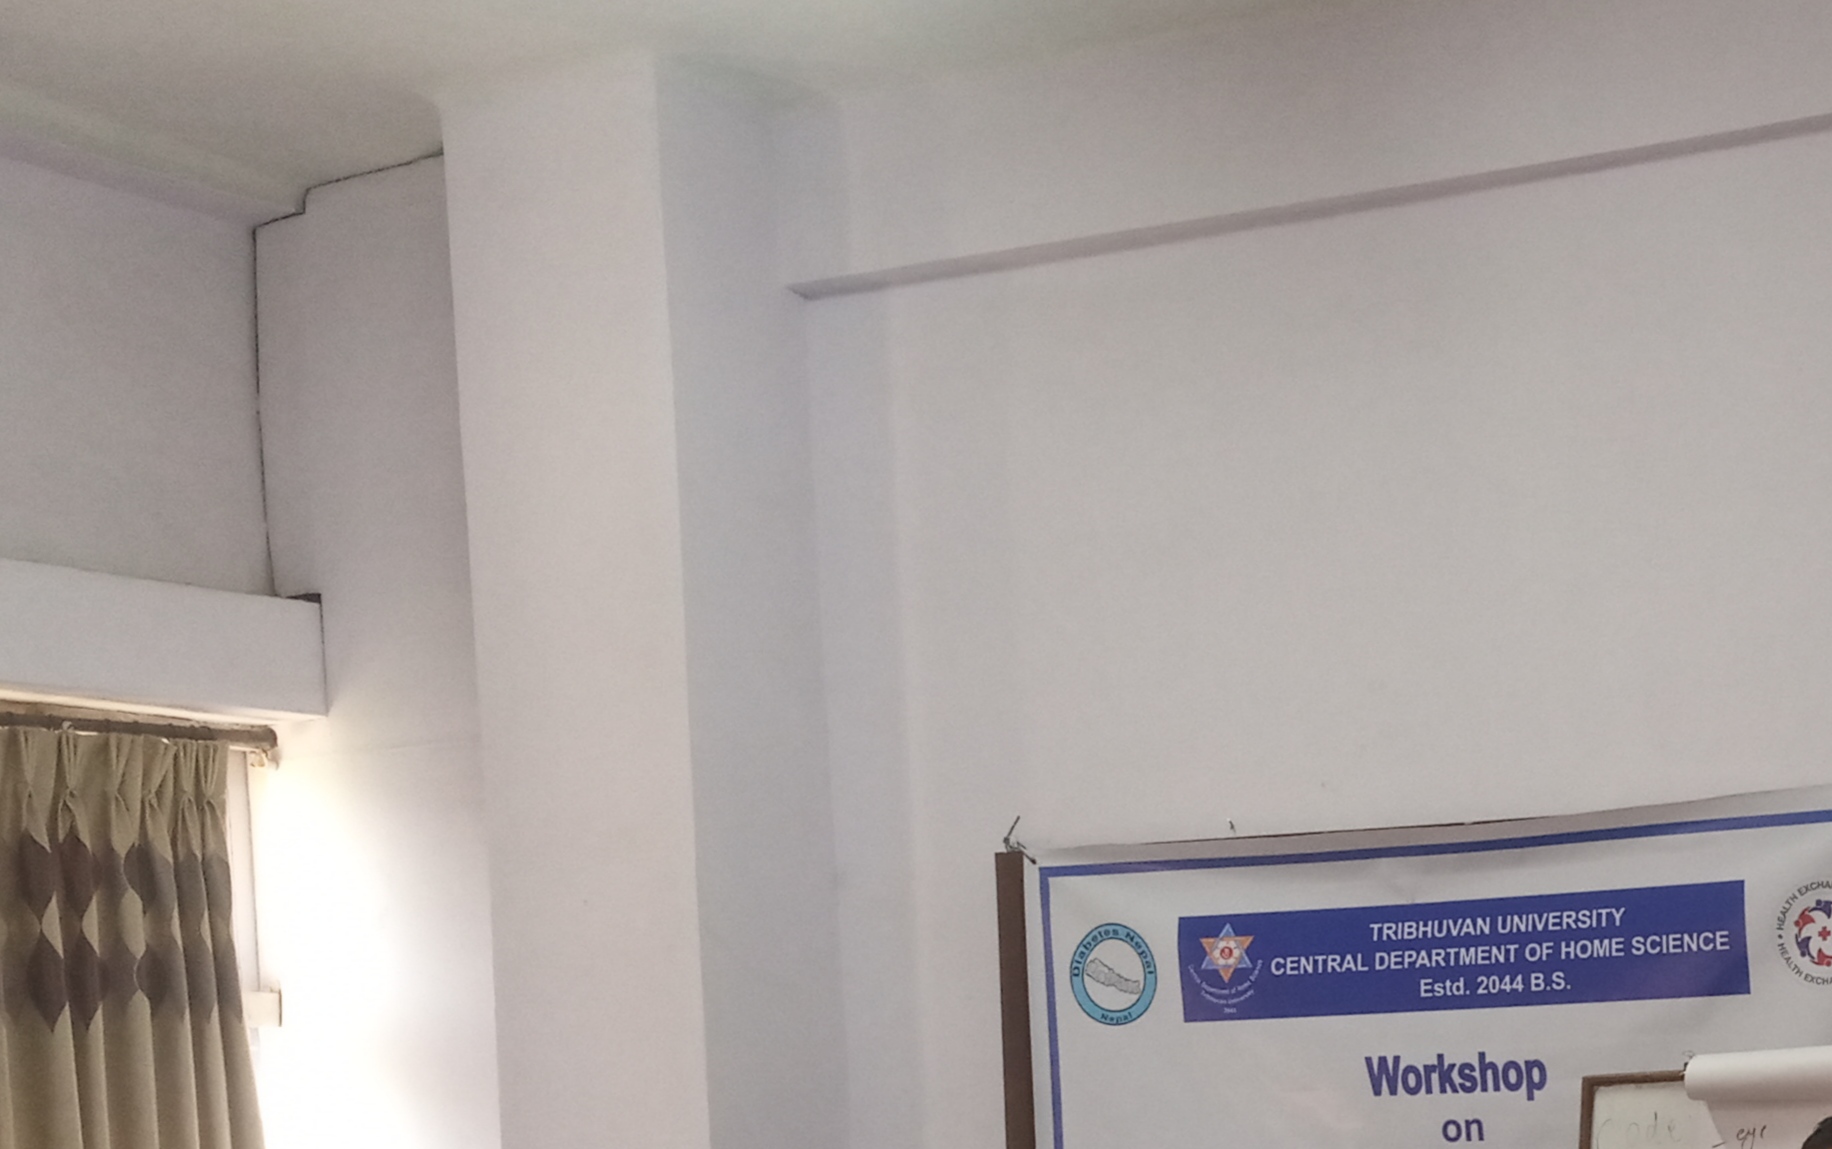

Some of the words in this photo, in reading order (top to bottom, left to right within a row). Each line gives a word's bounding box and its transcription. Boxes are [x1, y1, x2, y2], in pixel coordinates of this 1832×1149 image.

[1369, 917, 1491, 942] TRIBHUVAN
[1497, 908, 1625, 934] UNIVERSITY
[1776, 893, 1798, 931] HEALTH
[1125, 932, 1154, 975] Nepal
[1271, 952, 1368, 976] CENTRAL
[1375, 945, 1518, 971] DEPARTMENT
[1524, 942, 1554, 961] OF
[1560, 939, 1625, 961] HOME
[1631, 931, 1730, 955] SCIENCE
[1777, 942, 1805, 978] HEALTH
[1420, 978, 1470, 997] Estd.
[1476, 975, 1523, 994] 2044
[1530, 971, 1571, 992] B.S.
[1101, 1012, 1133, 1023] Nepal
[1365, 1051, 1547, 1101] Workshop
[1442, 1117, 1485, 1143] on
